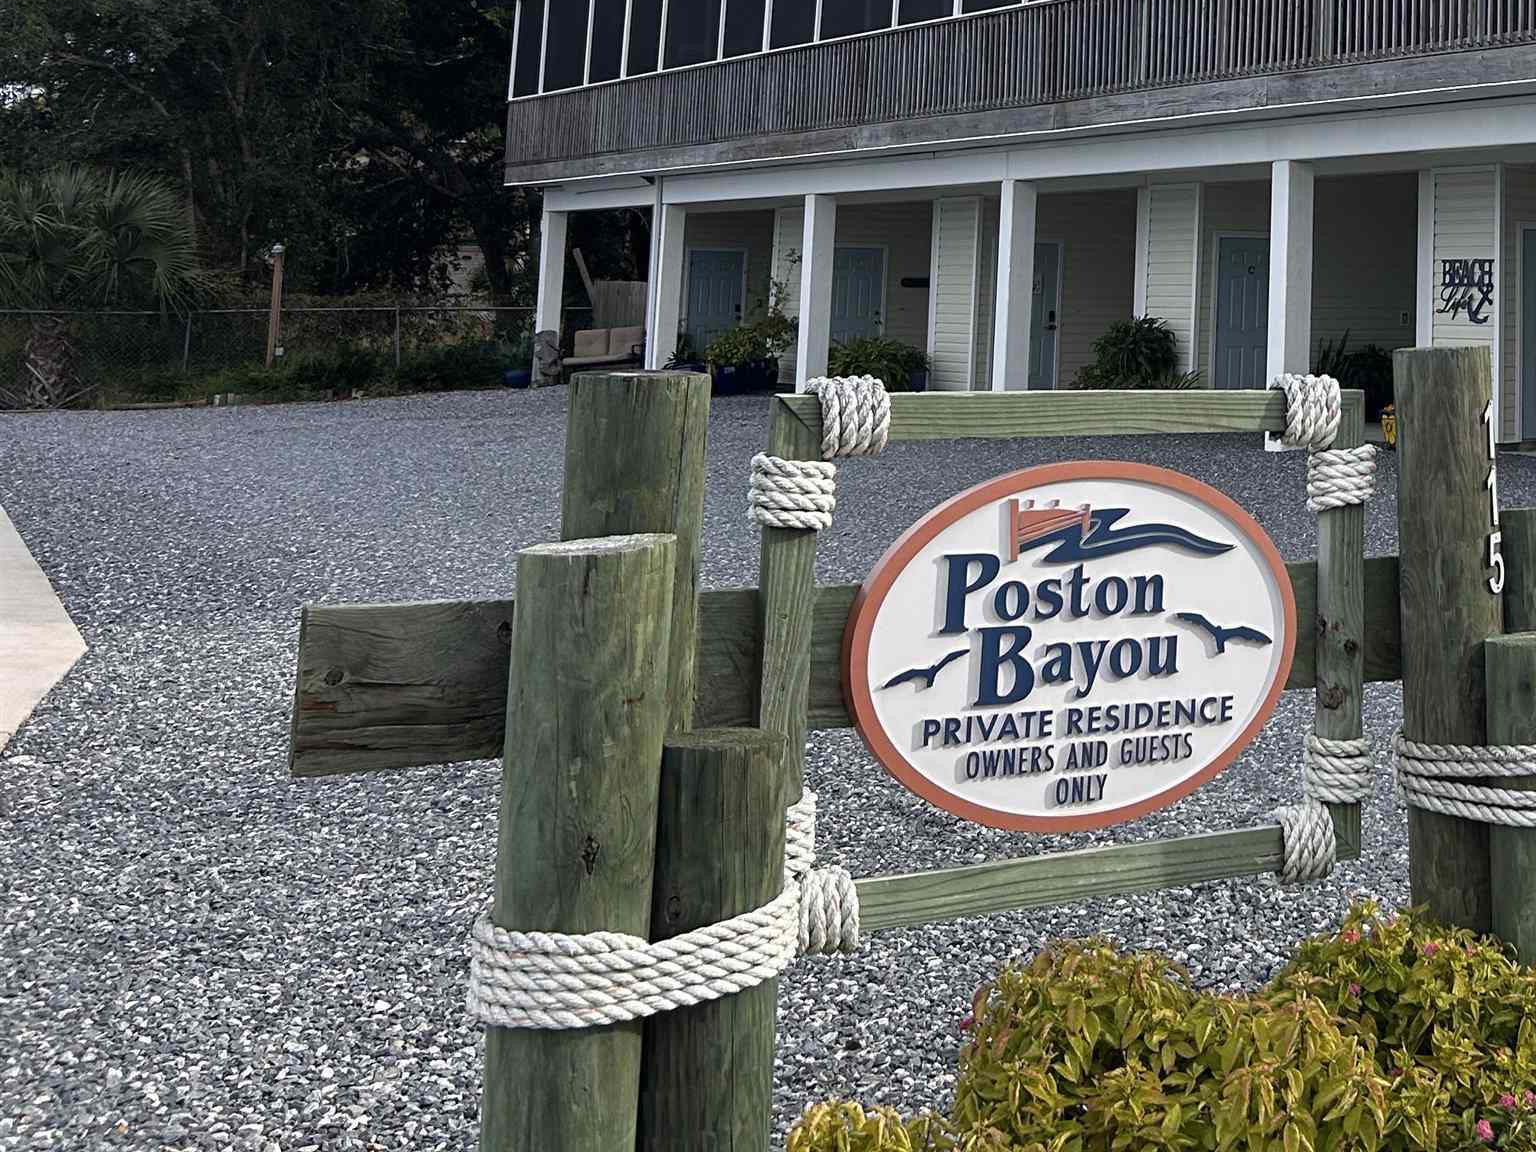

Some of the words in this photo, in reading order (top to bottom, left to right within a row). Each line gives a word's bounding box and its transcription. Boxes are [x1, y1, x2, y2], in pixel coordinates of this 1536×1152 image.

[1441, 258, 1496, 287] BEACH
[1484, 399, 1505, 594] 115
[939, 552, 1166, 635] Poston
[972, 625, 1180, 707] Bayou
[921, 709, 1054, 747] PRIVATE
[1065, 695, 1235, 736] RESIDENCE
[965, 744, 1056, 780] OWNERS
[1065, 740, 1109, 771] AND
[1120, 732, 1194, 766] GUESTS
[1055, 774, 1109, 805] ONLY
